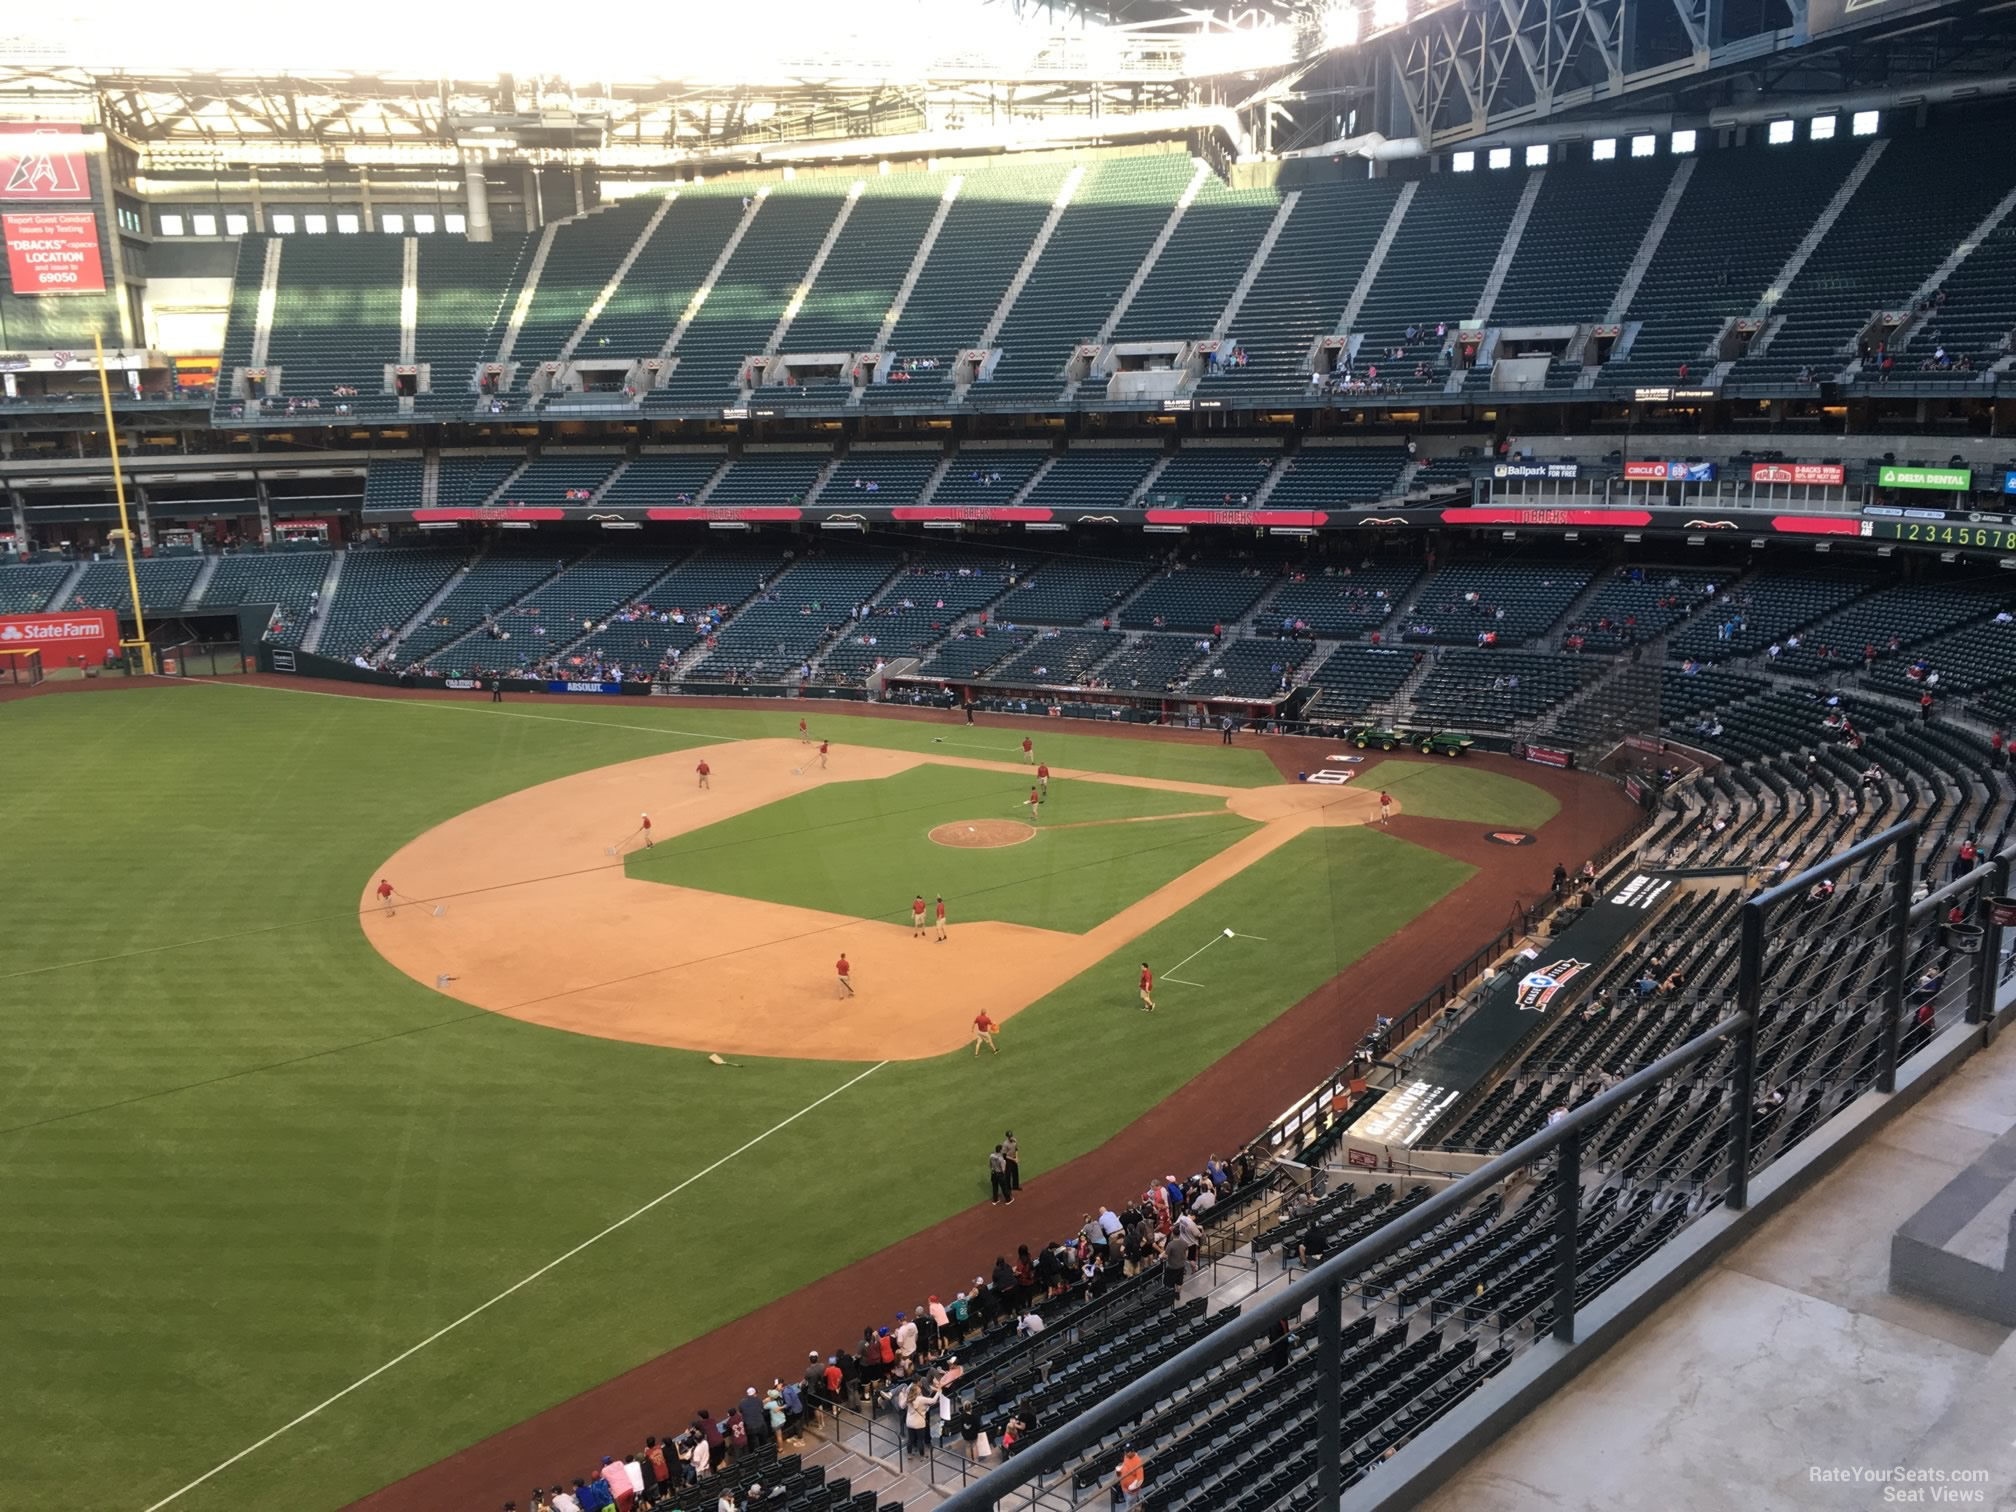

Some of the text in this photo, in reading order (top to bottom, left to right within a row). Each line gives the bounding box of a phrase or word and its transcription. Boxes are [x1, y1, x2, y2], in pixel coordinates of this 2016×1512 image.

[8, 215, 92, 225] Report Guest Conduct
[45, 226, 54, 234] by
[56, 225, 84, 234] Texting
[25, 252, 84, 264] LOCATION
[39, 272, 77, 283] 69050
[1508, 466, 1547, 477] Ballpark
[1795, 466, 1822, 474] D-BACKS
[1897, 473, 1965, 485] DELTA DENTAL
[1861, 521, 1873, 529] CLE
[1896, 523, 2016, 550] 1 2 3 4 5 6 7 8
[1548, 963, 1571, 978] FIELD
[1523, 987, 1541, 1004] CHASE
[1417, 1086, 1445, 1111] CASINOS
[1365, 1082, 1432, 1136] GILA RIVER
